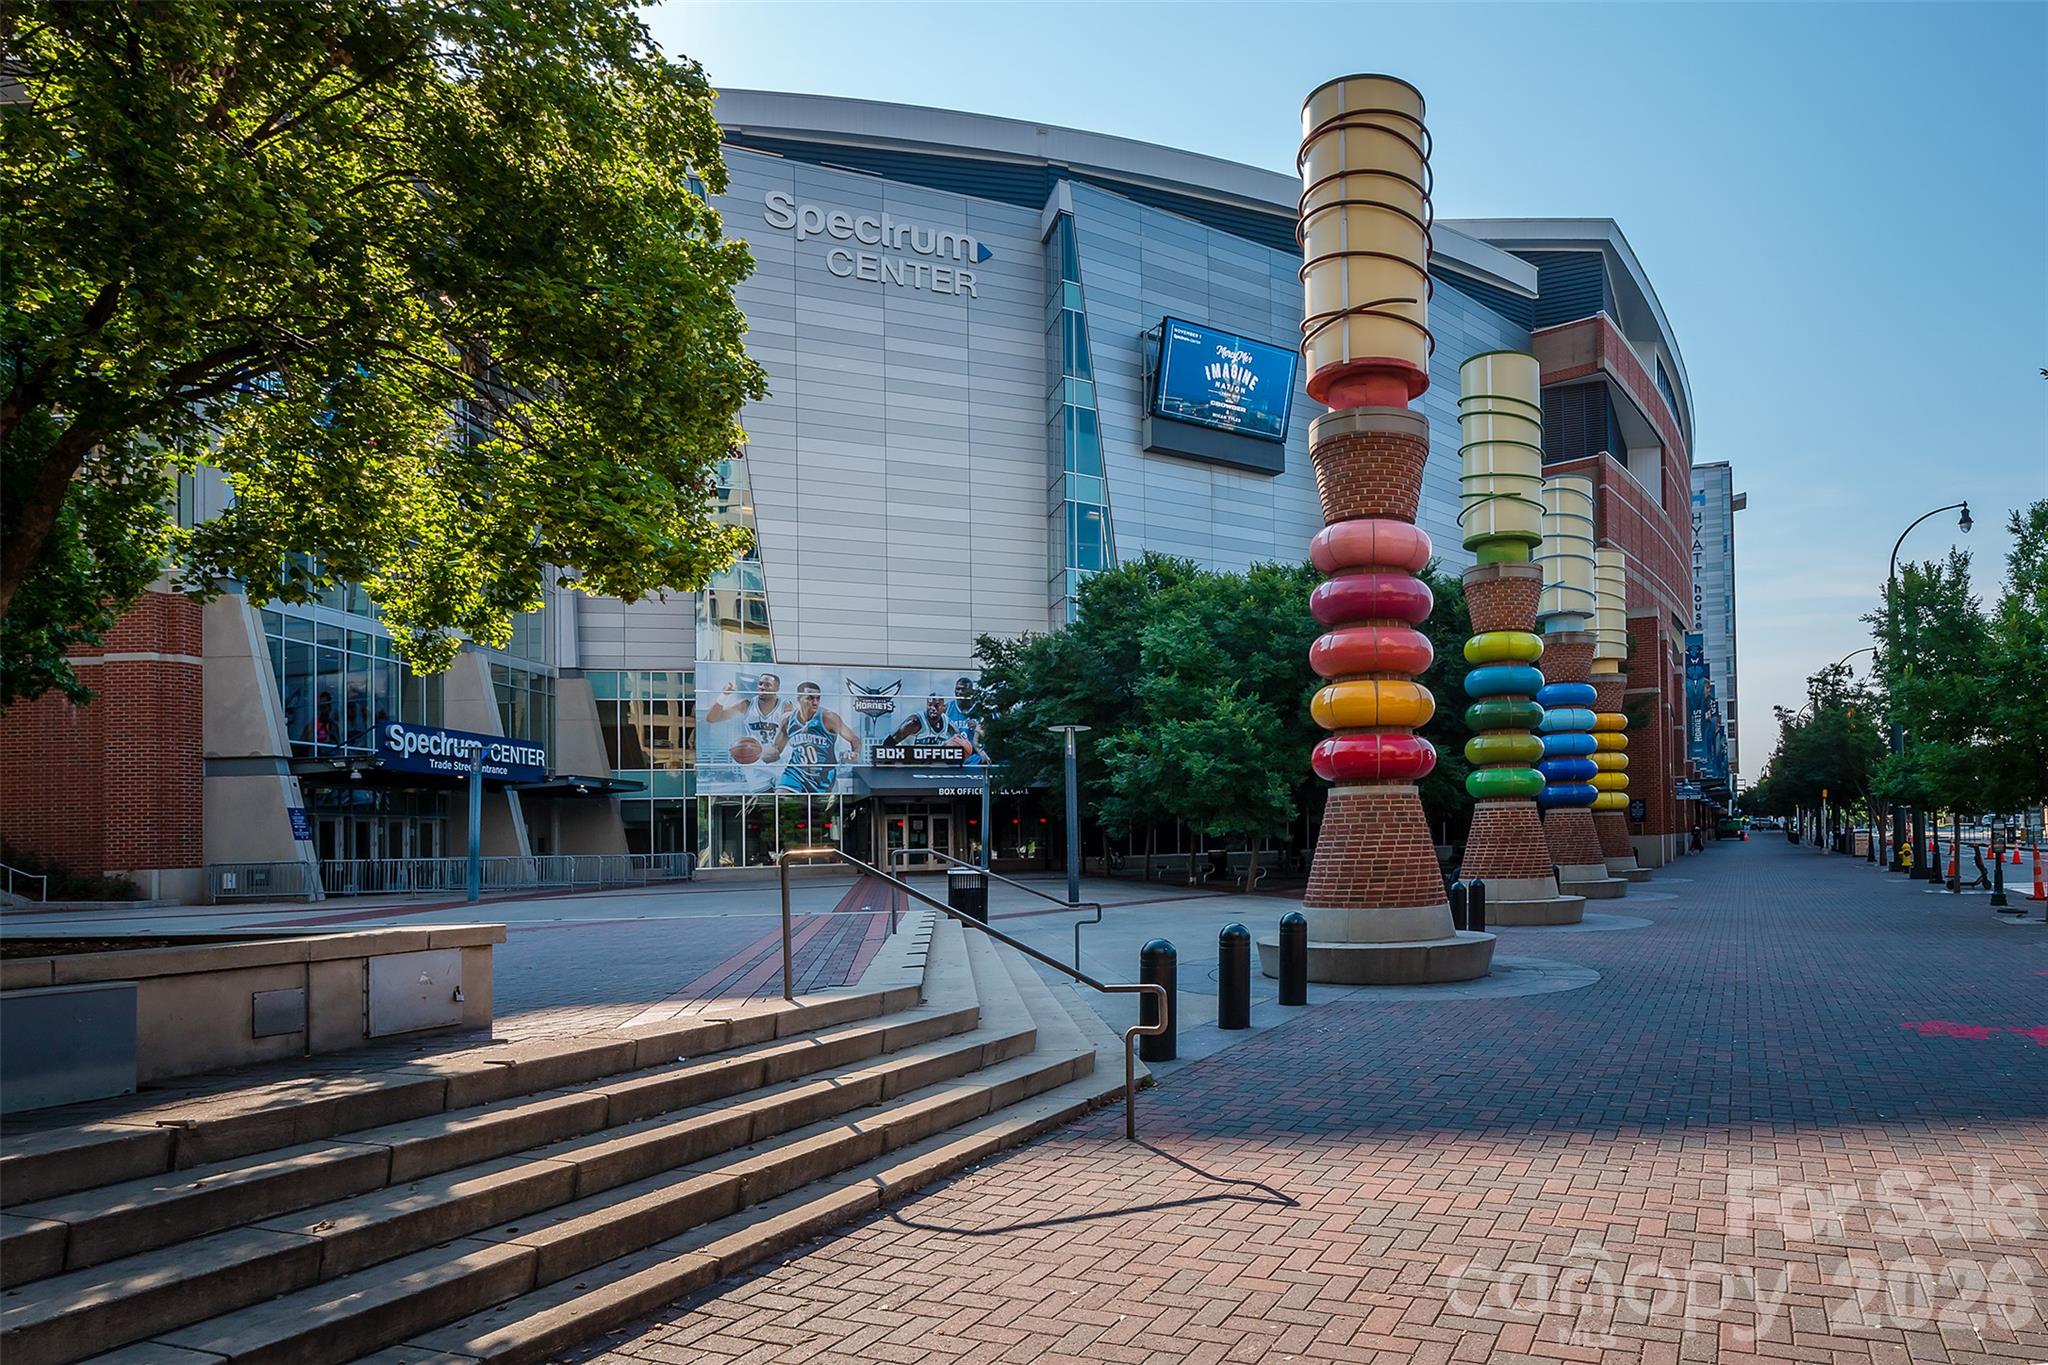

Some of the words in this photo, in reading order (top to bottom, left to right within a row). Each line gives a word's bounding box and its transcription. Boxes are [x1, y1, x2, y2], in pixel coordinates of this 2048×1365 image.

[763, 190, 979, 264] Spectrum
[825, 247, 979, 299] CENTER
[1204, 362, 1259, 391] IMAGINE
[1214, 381, 1246, 394] NATION
[1691, 513, 1703, 578] HYATT
[1694, 583, 1703, 629] house
[856, 700, 894, 711] HORNETS
[1693, 709, 1703, 742] HORNETS
[429, 758, 453, 770] Trade
[453, 761, 472, 772] Stree
[481, 764, 508, 775] ntrance
[491, 743, 546, 767] CENTER
[876, 748, 906, 760] BOX
[913, 748, 963, 760] OFFICE
[938, 787, 955, 796] BOX
[956, 787, 984, 796] OFFICE
